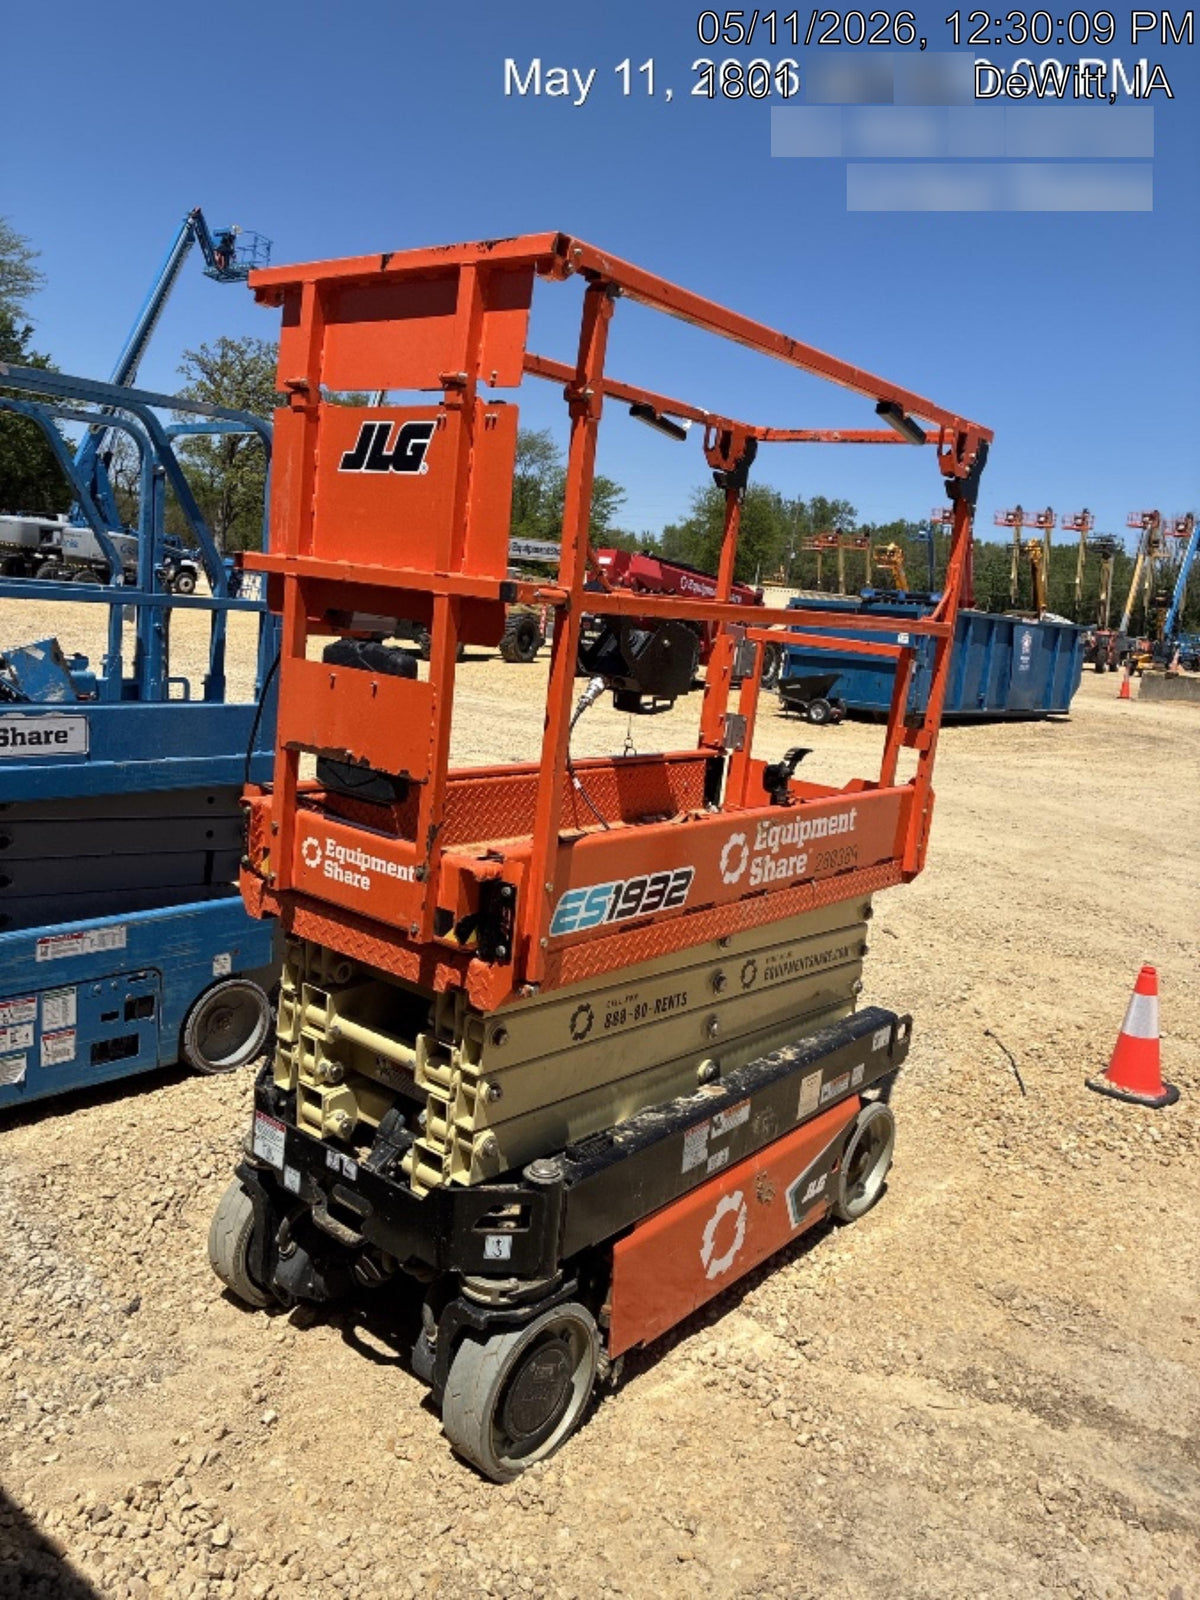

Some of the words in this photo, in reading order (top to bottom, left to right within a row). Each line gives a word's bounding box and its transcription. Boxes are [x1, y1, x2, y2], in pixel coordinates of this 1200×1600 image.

[337, 420, 437, 474] JLG
[753, 807, 858, 854] Equipment
[323, 859, 371, 892] Share
[325, 837, 416, 883] Equipment
[749, 849, 808, 886] Share
[550, 865, 696, 937] ES1932
[603, 991, 688, 1029] 888-80-RENTS
